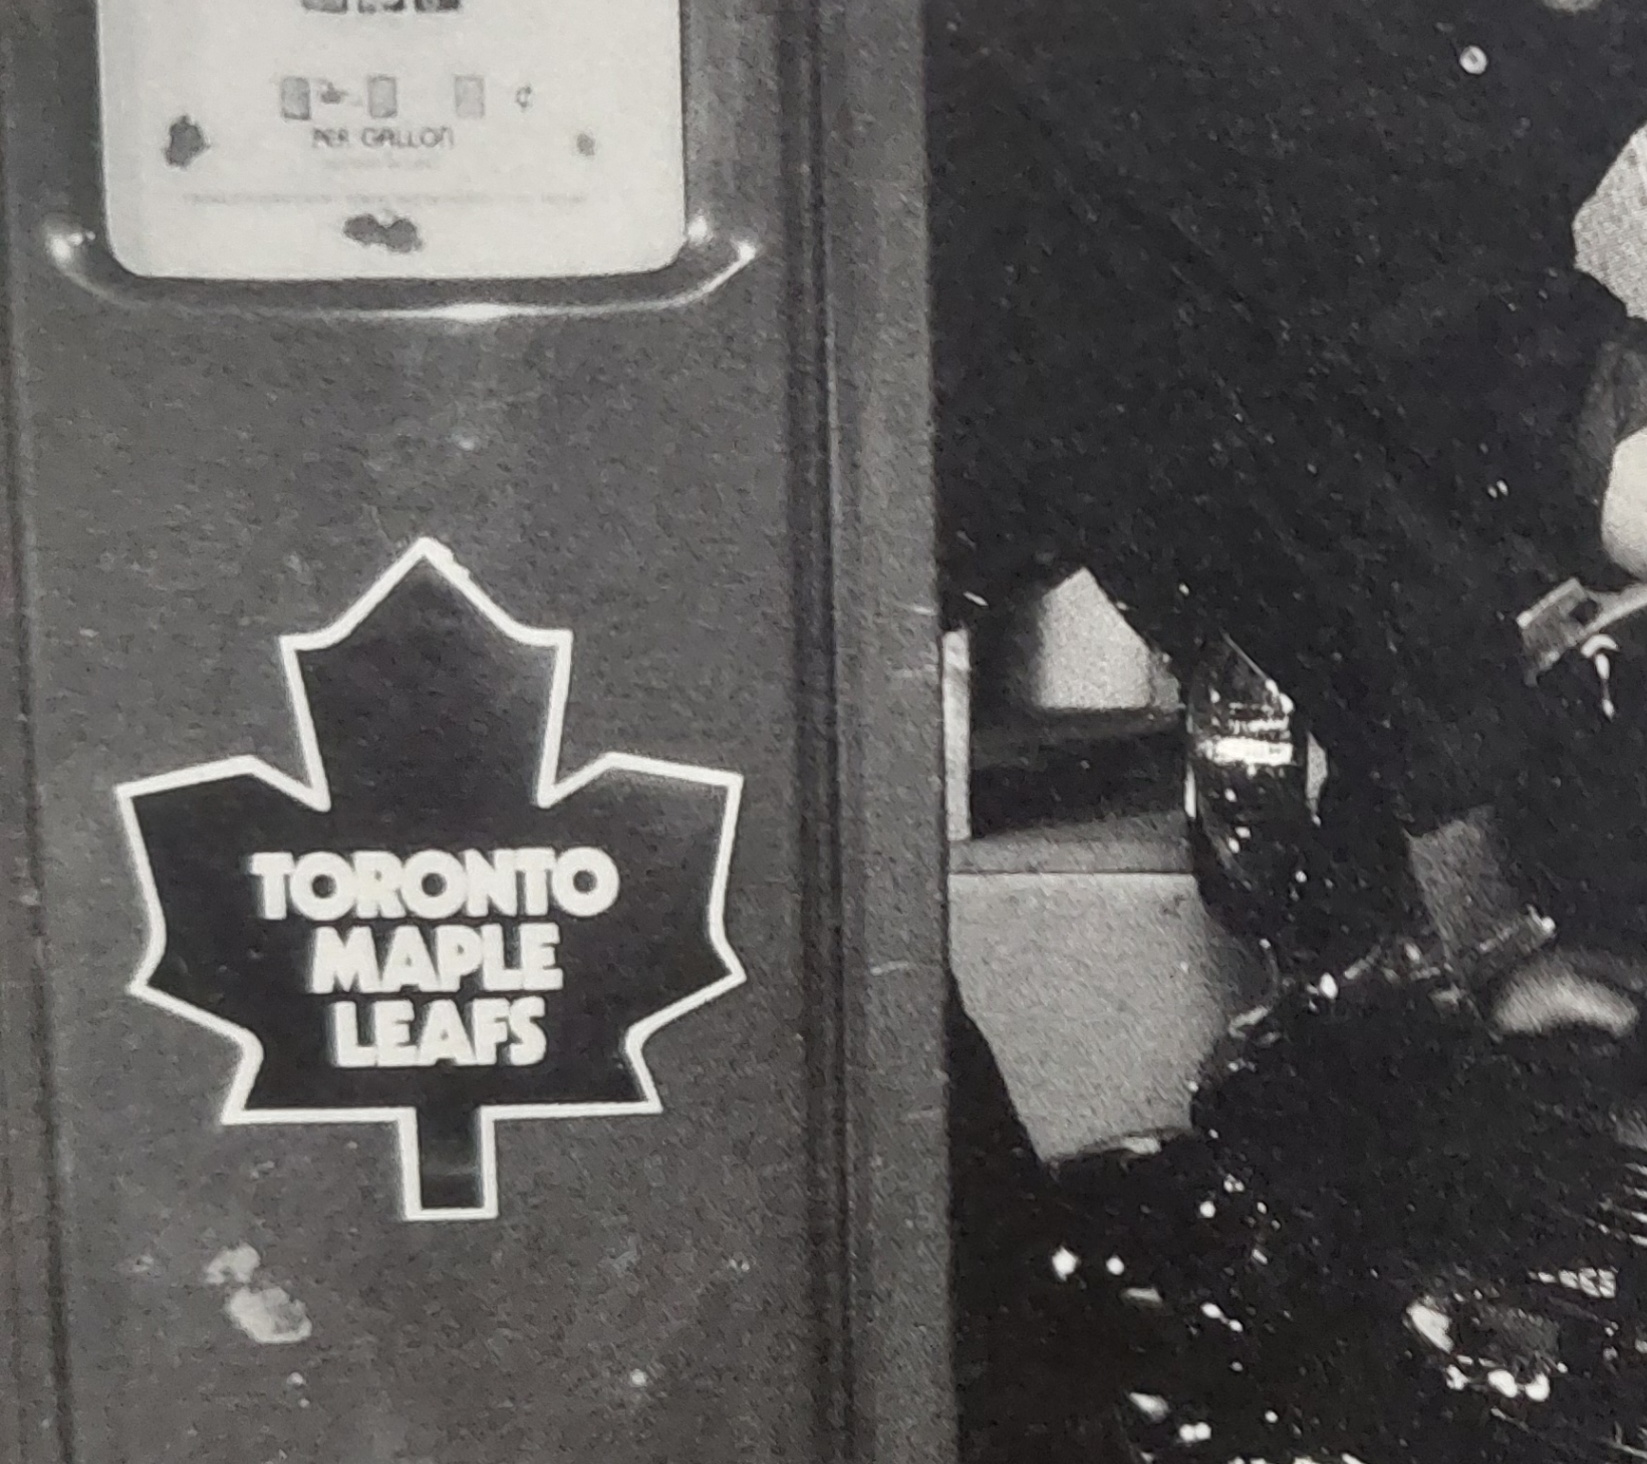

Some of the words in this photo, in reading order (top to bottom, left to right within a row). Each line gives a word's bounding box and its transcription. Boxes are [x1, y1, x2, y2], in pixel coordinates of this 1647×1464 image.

[248, 846, 620, 921] TORONTO
[309, 922, 564, 995] MAPLE
[330, 995, 547, 1069] LEAFS
